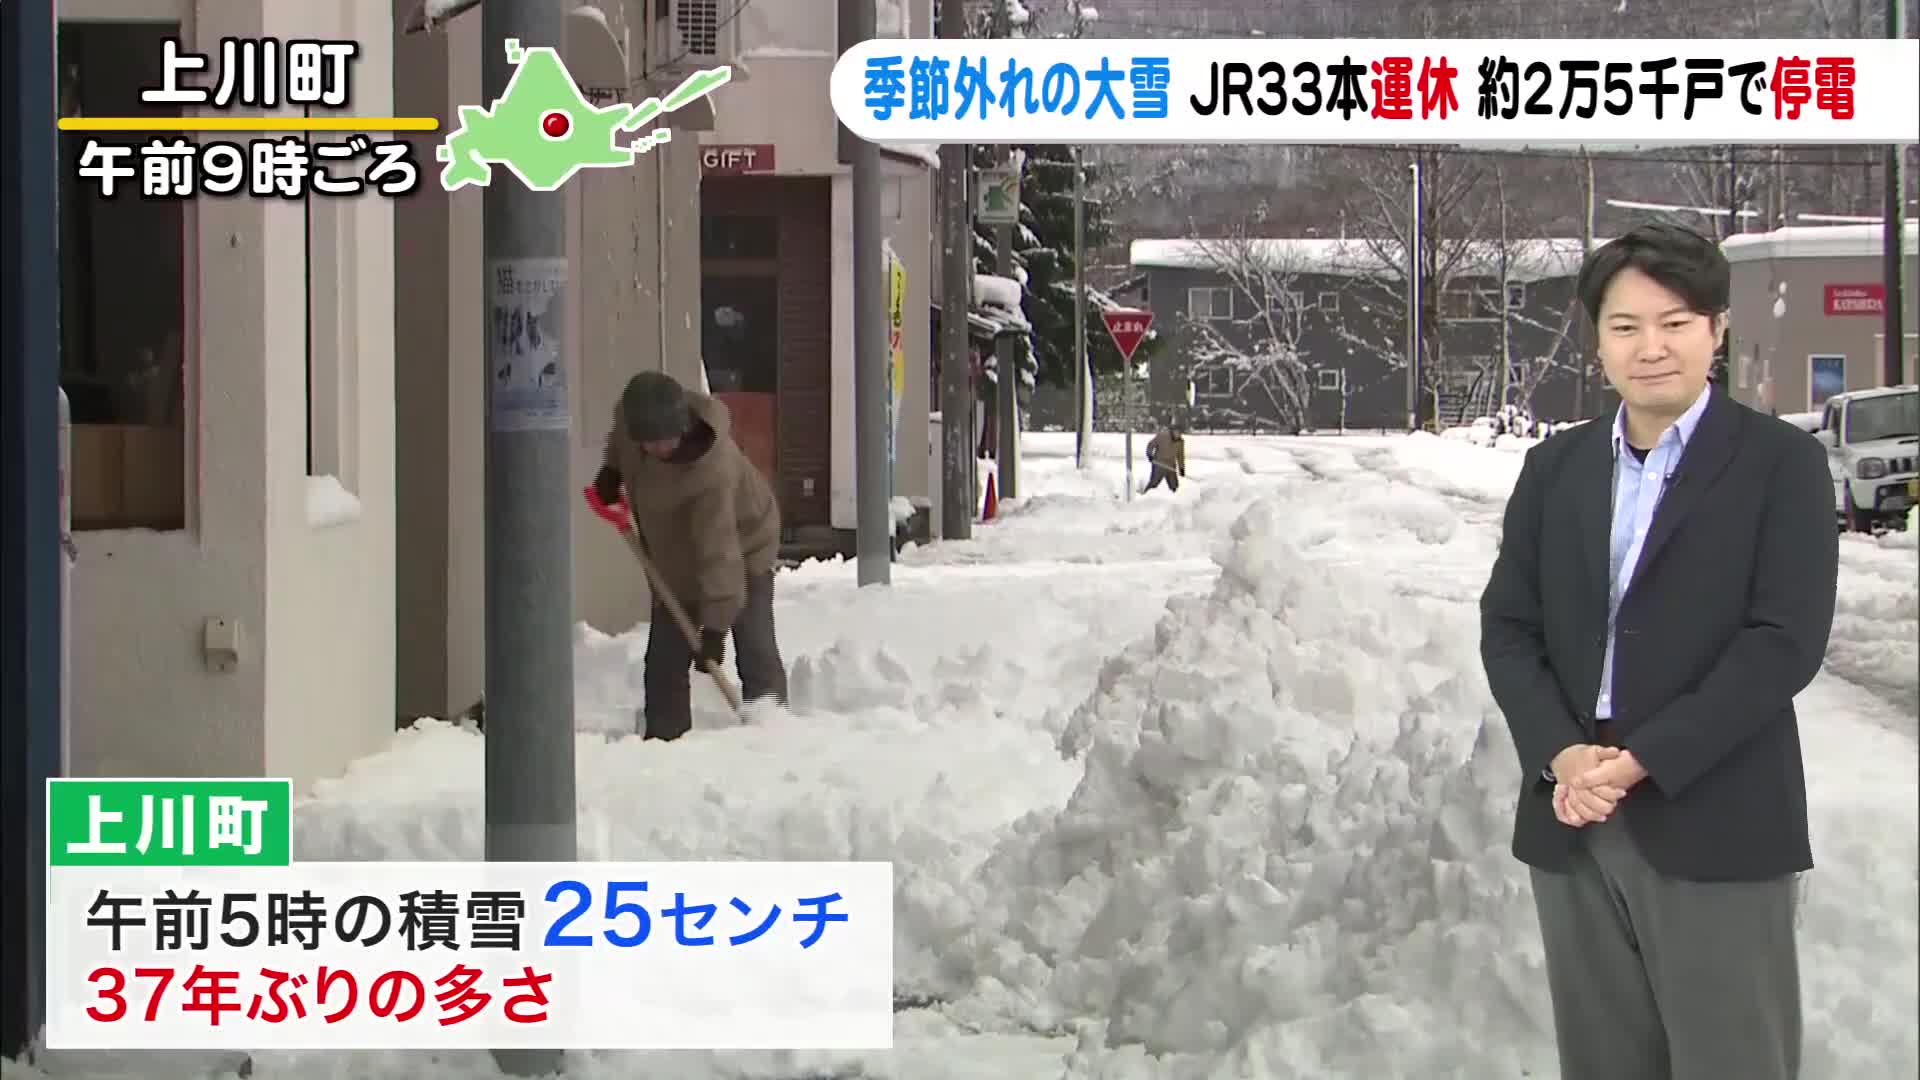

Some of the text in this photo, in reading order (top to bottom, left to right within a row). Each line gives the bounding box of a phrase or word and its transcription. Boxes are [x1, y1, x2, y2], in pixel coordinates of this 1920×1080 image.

[703, 148, 758, 169] GIFT
[1112, 320, 1144, 334] 止まれ
